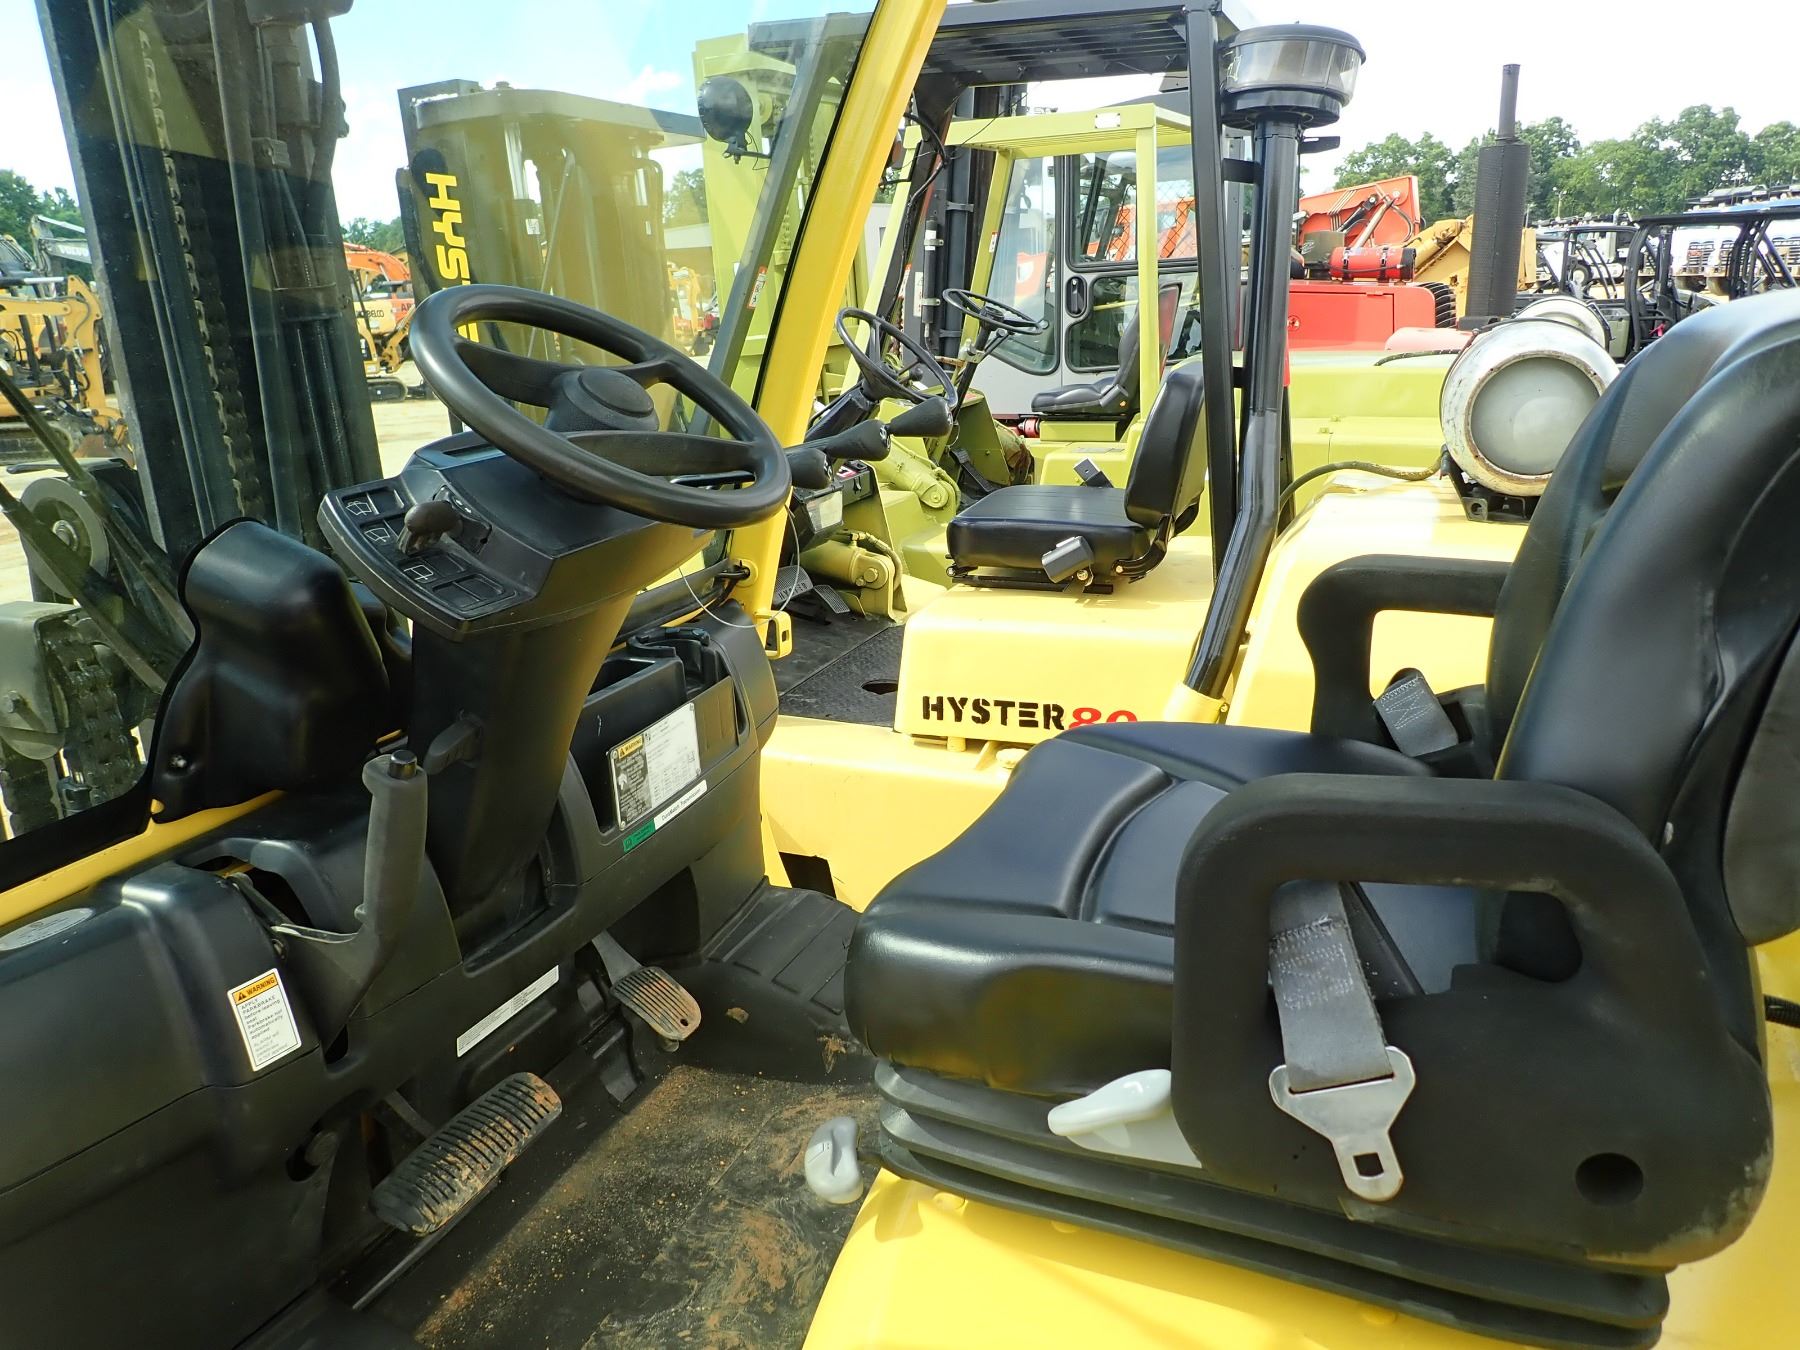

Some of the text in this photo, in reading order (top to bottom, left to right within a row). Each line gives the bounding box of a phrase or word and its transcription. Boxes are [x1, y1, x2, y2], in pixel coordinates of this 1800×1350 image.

[922, 695, 1065, 730] HYSTER
[247, 977, 275, 995] WARNING
[242, 998, 258, 1009] APPLY
[243, 995, 275, 1014] PARKBRAKE
[245, 1009, 260, 1019] before
